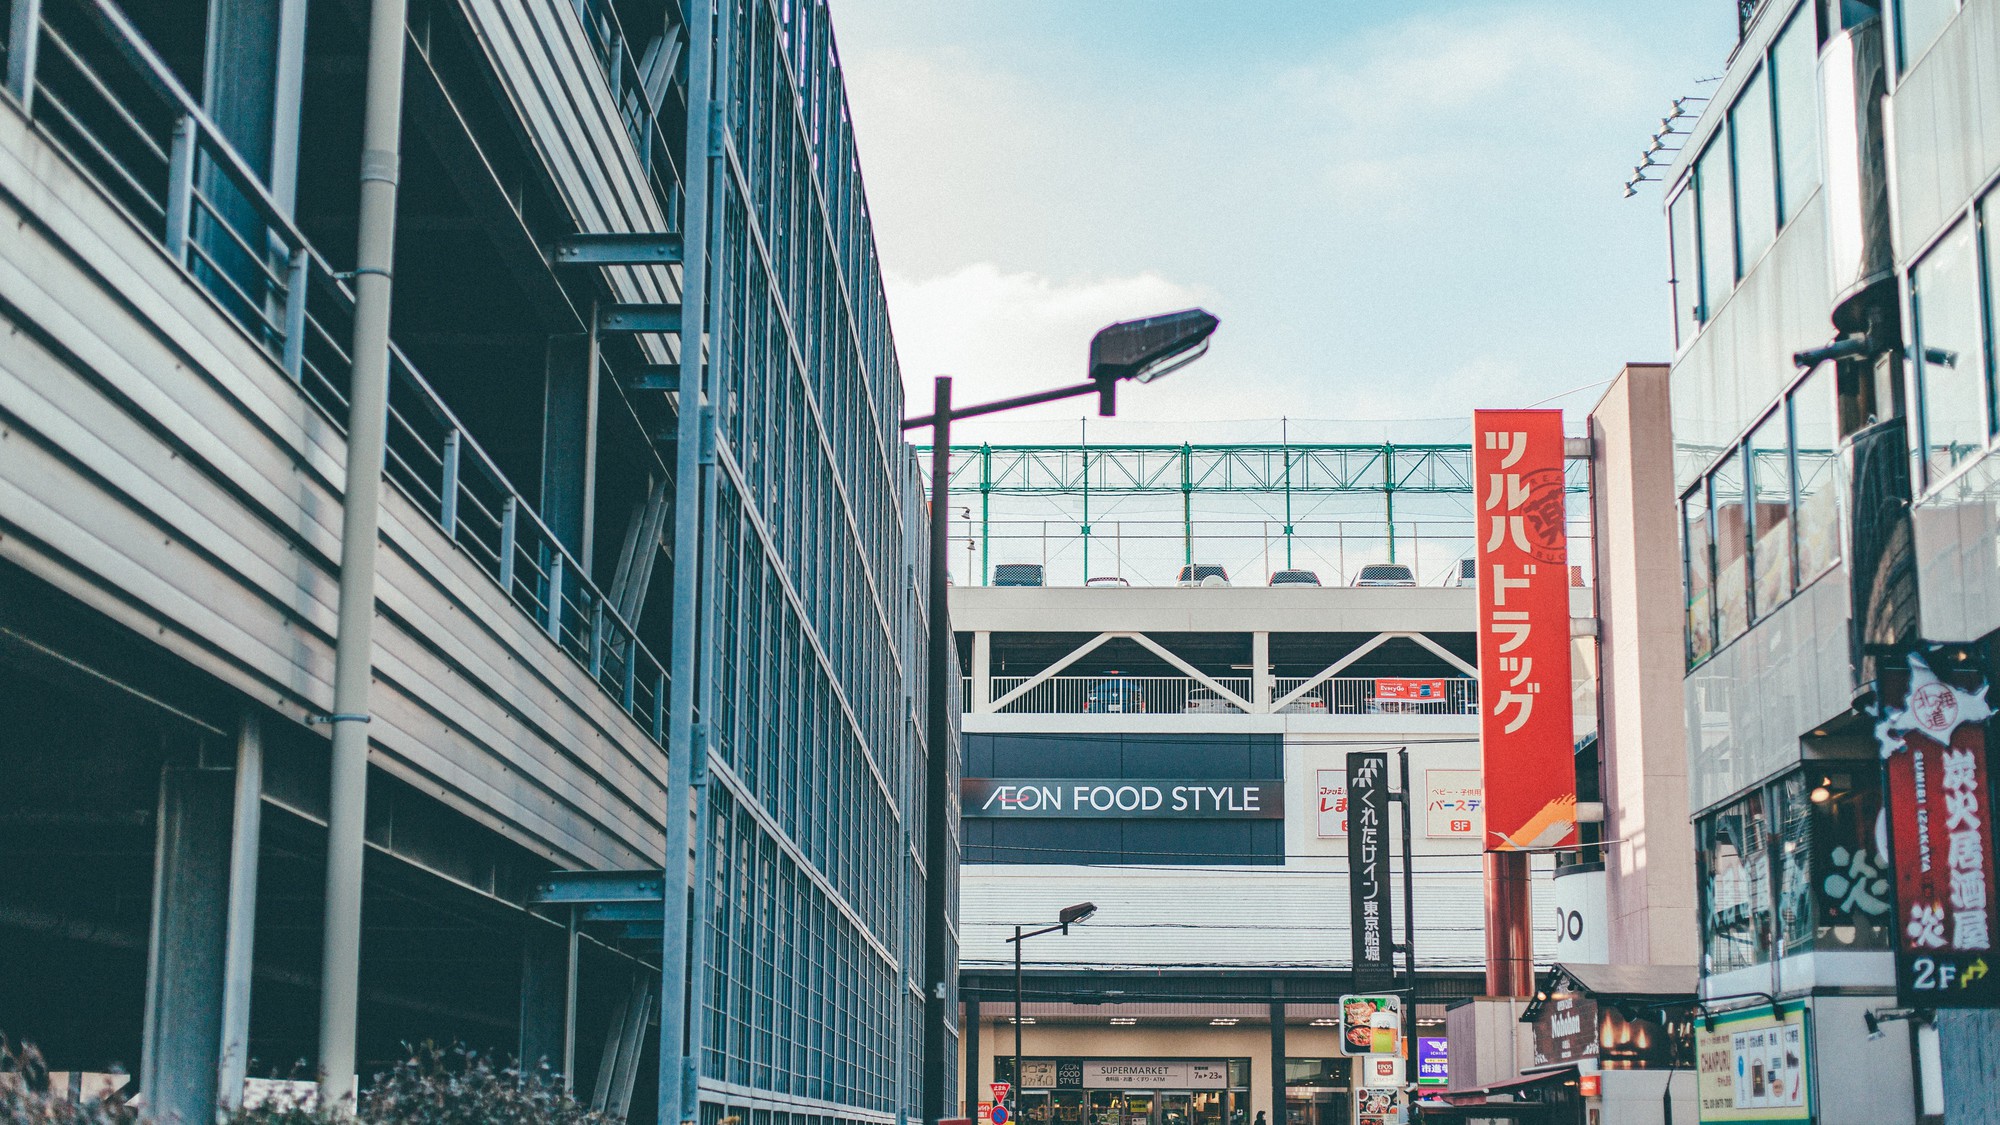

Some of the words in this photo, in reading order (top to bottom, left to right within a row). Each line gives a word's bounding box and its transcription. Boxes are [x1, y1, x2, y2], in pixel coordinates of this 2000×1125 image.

[1485, 431, 1540, 735] ツルハドラッグ
[1073, 785, 1162, 811] FOOD
[1171, 785, 1260, 811] STYLE
[1914, 751, 1927, 804] SUMIBI
[1453, 822, 1468, 831] 3F
[1918, 809, 1931, 873] IZAKAYA
[1942, 748, 1990, 950] 炭火居酒屋
[1358, 789, 1381, 962] くれたけイン東京船堀
[1913, 958, 1956, 990] 2F
[1059, 1077, 1080, 1085] STYLE
[1101, 1066, 1169, 1075] SUPERMARKET
